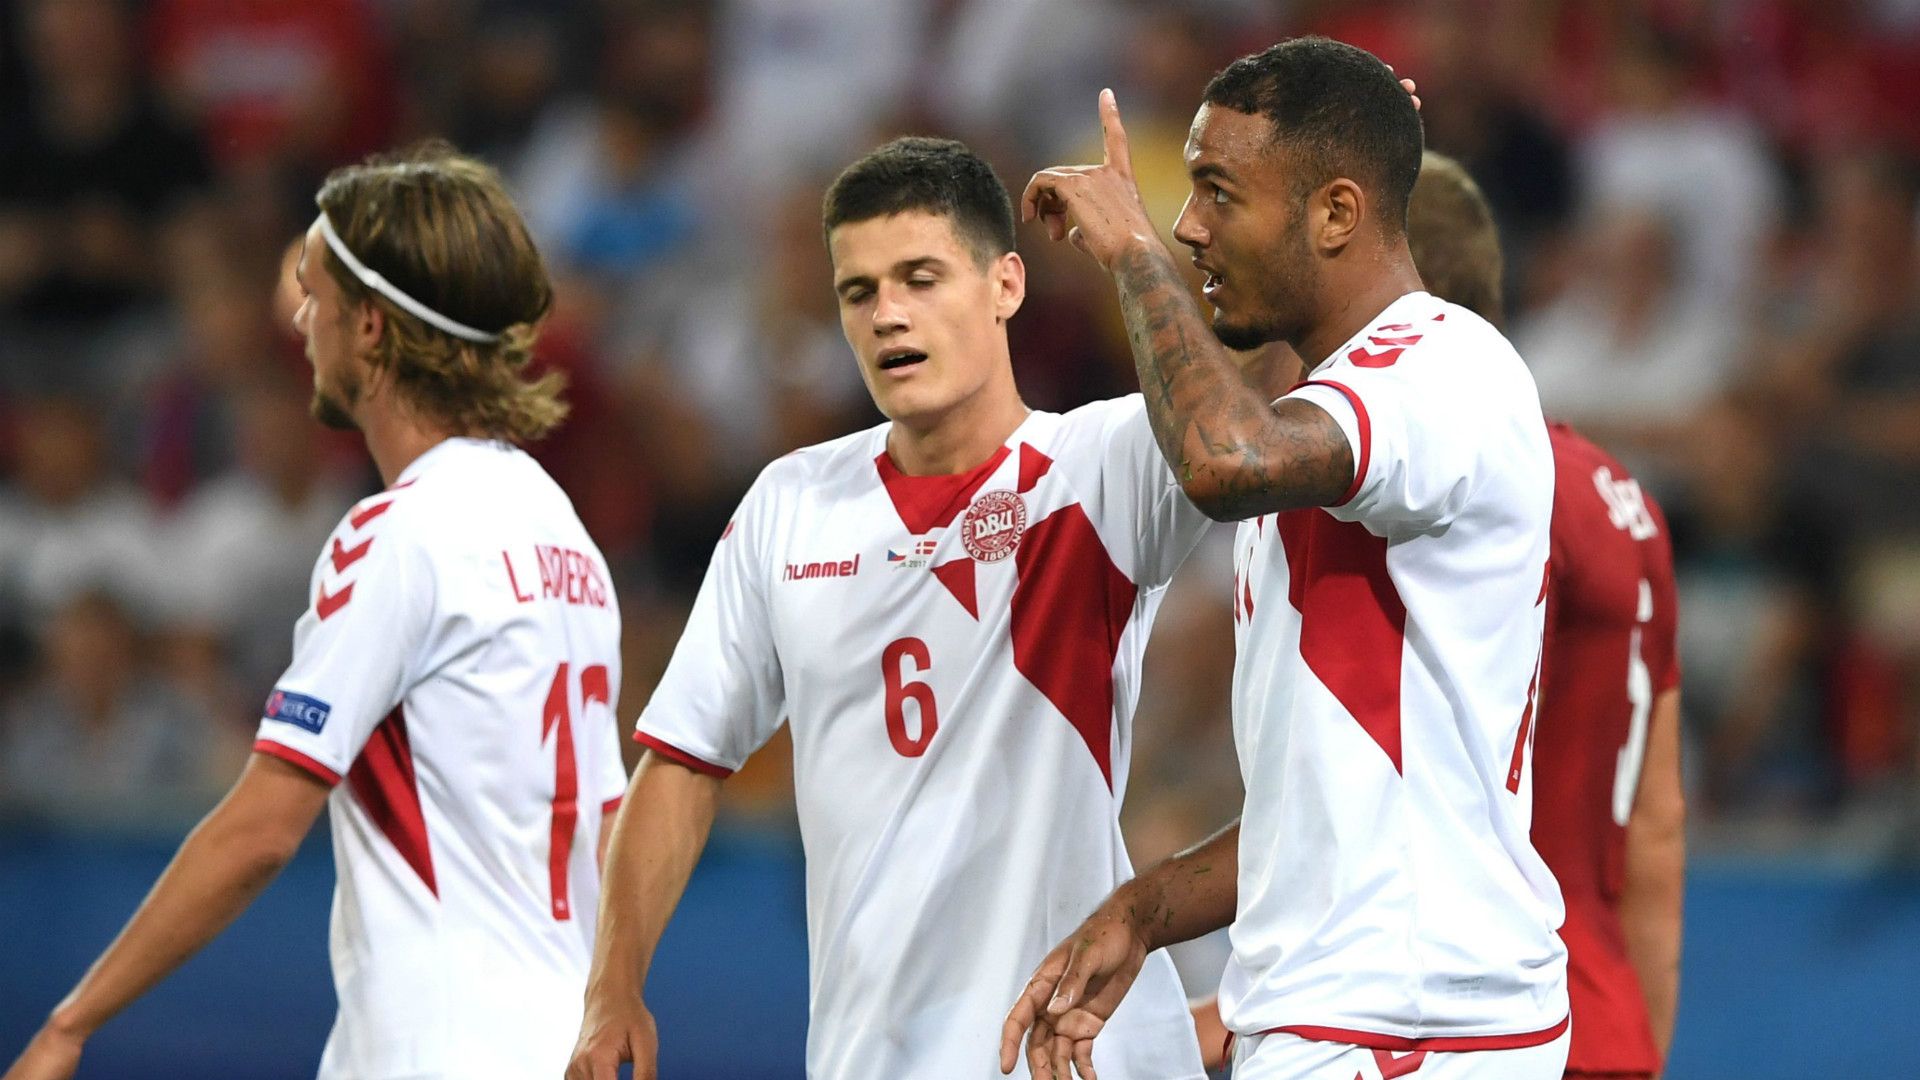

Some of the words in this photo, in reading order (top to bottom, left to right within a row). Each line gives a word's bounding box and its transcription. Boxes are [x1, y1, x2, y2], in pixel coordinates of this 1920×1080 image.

[974, 509, 1014, 541] DBU
[783, 553, 860, 582] hummel
[881, 636, 939, 758] 6
